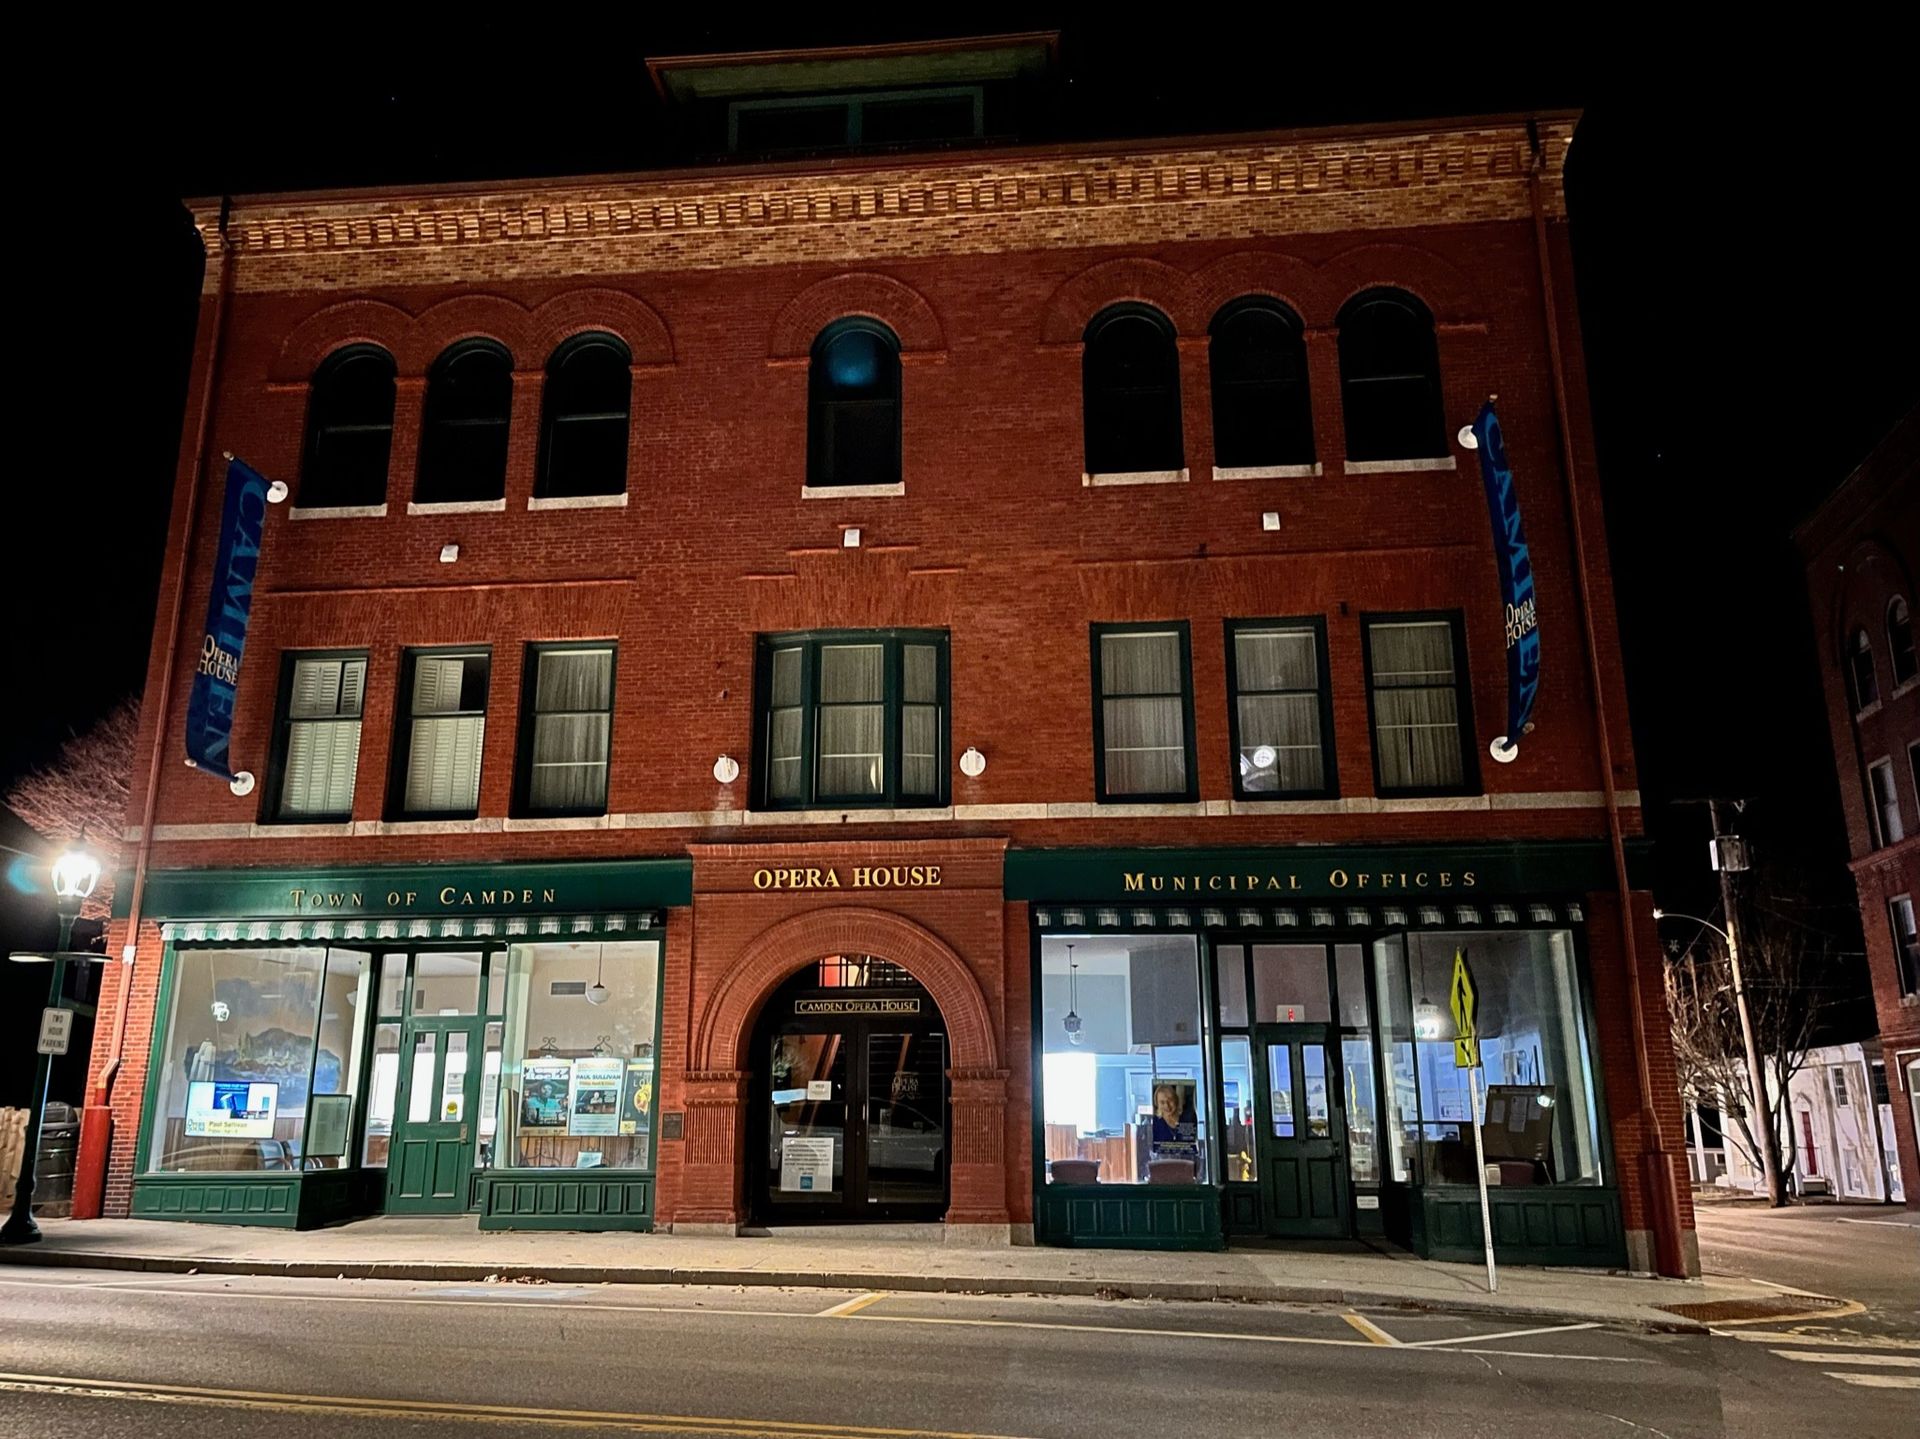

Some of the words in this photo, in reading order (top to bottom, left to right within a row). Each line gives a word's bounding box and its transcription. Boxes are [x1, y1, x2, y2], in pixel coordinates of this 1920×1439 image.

[1506, 597, 1535, 624] OPERA
[1505, 610, 1538, 649] HOUSE
[203, 634, 238, 671] OPERA
[197, 648, 238, 687] HOUSE
[753, 868, 841, 889] OPERA
[852, 866, 942, 887] HOUSE
[1123, 872, 1302, 892] MUNICIPAL
[1329, 869, 1476, 889] OFFICES
[290, 889, 364, 908] TOWN
[387, 891, 417, 906] OF
[440, 887, 556, 906] CAMDEN
[799, 1001, 843, 1012] CAMDEN
[845, 1001, 879, 1012] OPERA
[880, 1000, 915, 1011] HOUSE
[52, 1014, 64, 1023] TWO
[47, 1027, 64, 1036] HOUR
[42, 1038, 66, 1049] PARKING
